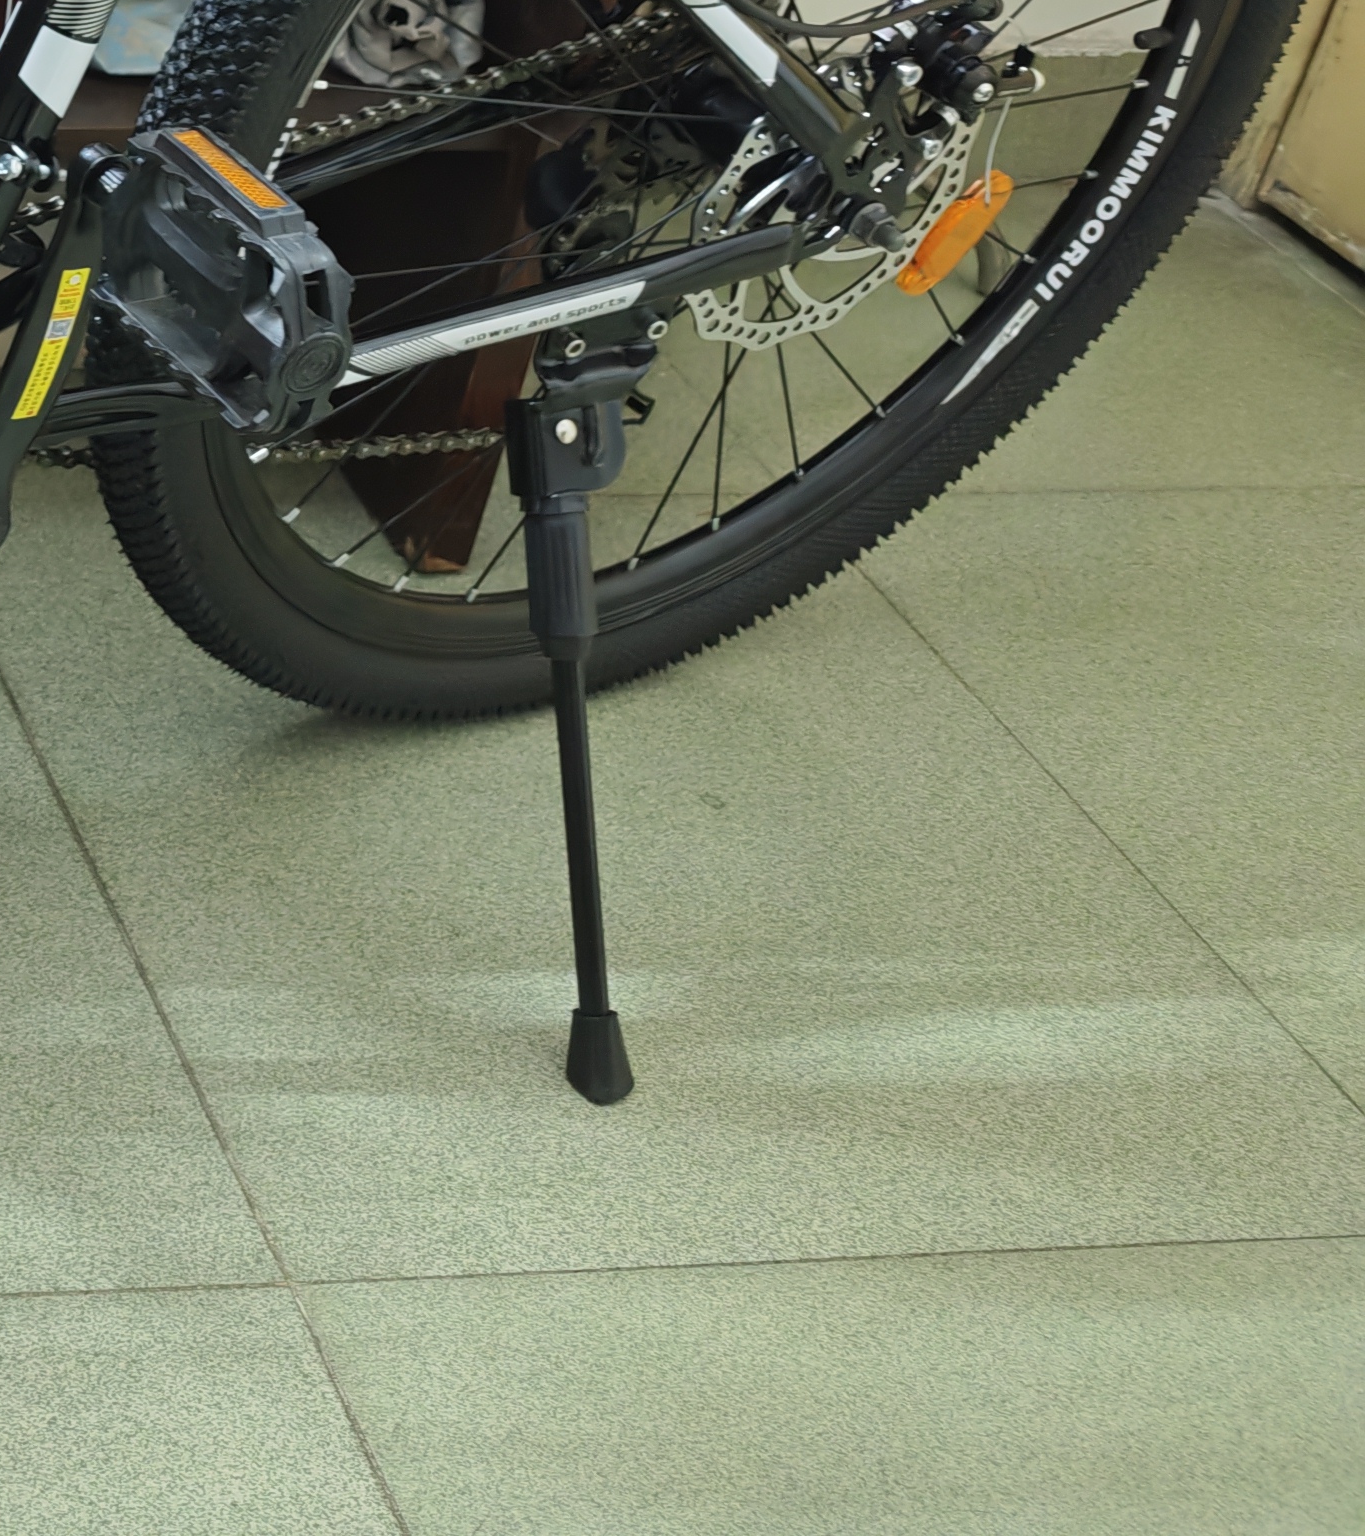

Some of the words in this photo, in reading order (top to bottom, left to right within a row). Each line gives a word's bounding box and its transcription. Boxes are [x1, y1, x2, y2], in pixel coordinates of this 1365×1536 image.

[1034, 104, 1179, 302] KIMMOORUI
[464, 324, 524, 346] power
[527, 312, 561, 329] and
[565, 295, 629, 320] sports
